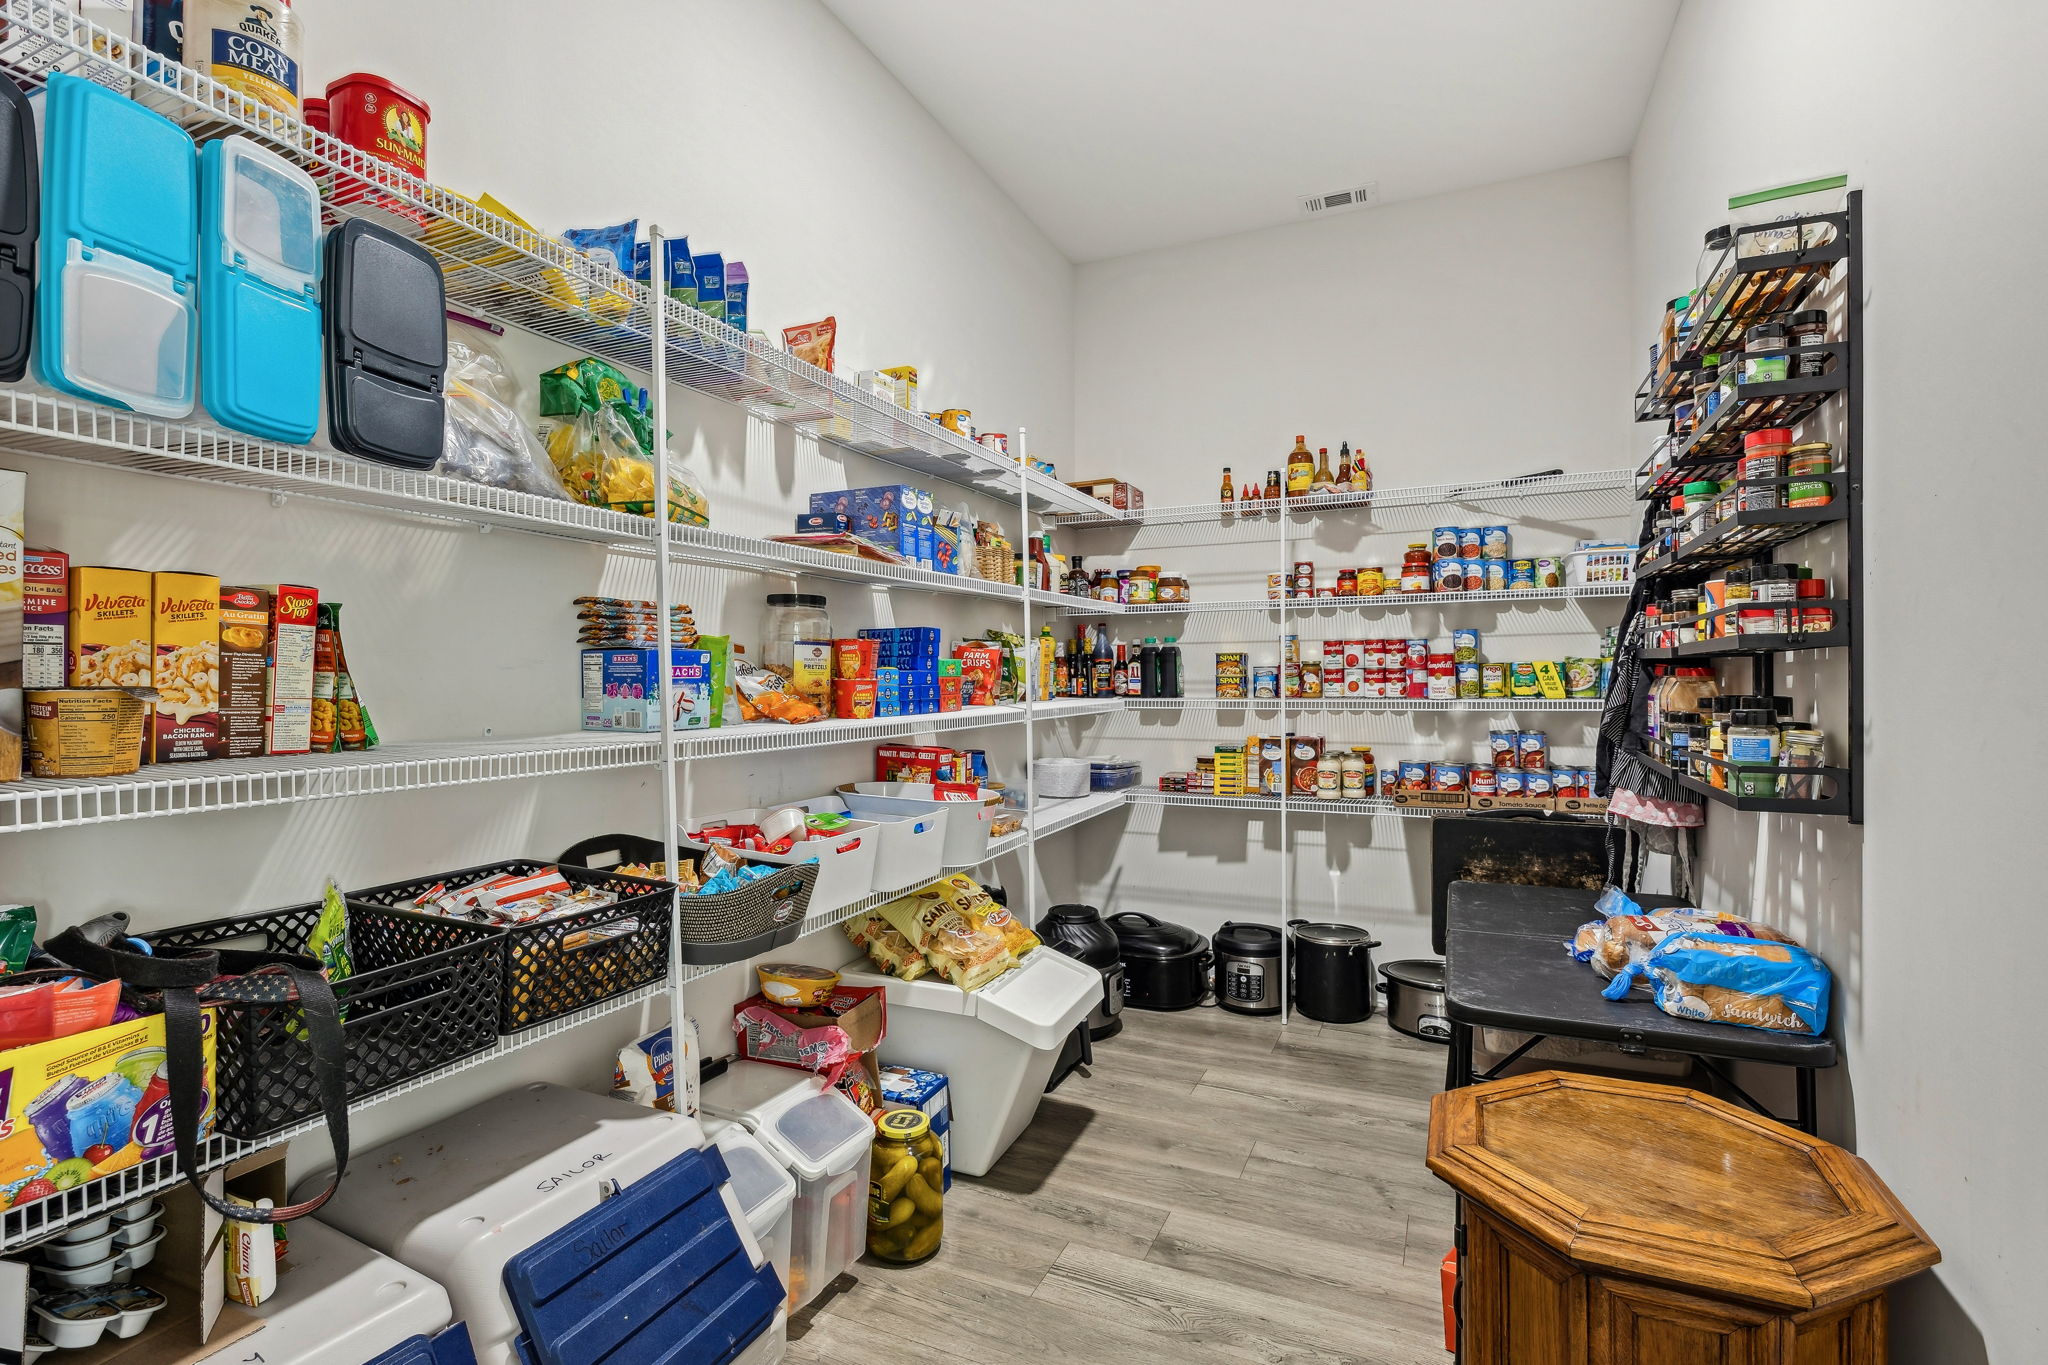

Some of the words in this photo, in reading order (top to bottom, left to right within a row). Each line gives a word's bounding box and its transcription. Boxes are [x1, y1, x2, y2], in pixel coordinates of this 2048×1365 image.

[239, 22, 282, 47] QUAKER
[228, 36, 289, 73] CORN
[228, 49, 289, 87] MEAL
[243, 72, 279, 91] YELLOW
[1800, 483, 1823, 491] SPICES
[23, 563, 62, 576] ccess
[85, 593, 146, 612] Velveeta
[160, 597, 215, 615] Velveeta
[280, 596, 314, 614] Stove
[97, 609, 135, 618] SKILLETS
[171, 611, 205, 620] SKILLETS
[236, 611, 265, 620] Gratin
[292, 606, 309, 619] Top
[961, 659, 991, 669] CRISPS
[963, 651, 990, 659] PARM
[1540, 665, 1550, 674] 4
[1676, 1005, 1705, 1018] White
[1721, 1004, 1803, 1028] Sandwich
[46, 1066, 68, 1077] Buena
[69, 1057, 92, 1068] Fuente
[102, 1042, 134, 1055] Vitaminas
[47, 1061, 66, 1071] Good
[66, 1051, 91, 1064] Source
[112, 1033, 140, 1046] Vitamins
[662, 1064, 673, 1075] BES
[142, 1114, 159, 1144] 1
[536, 1153, 613, 1193] SAILOR
[241, 1232, 251, 1274] Churu
[573, 1223, 628, 1265] Sailor
